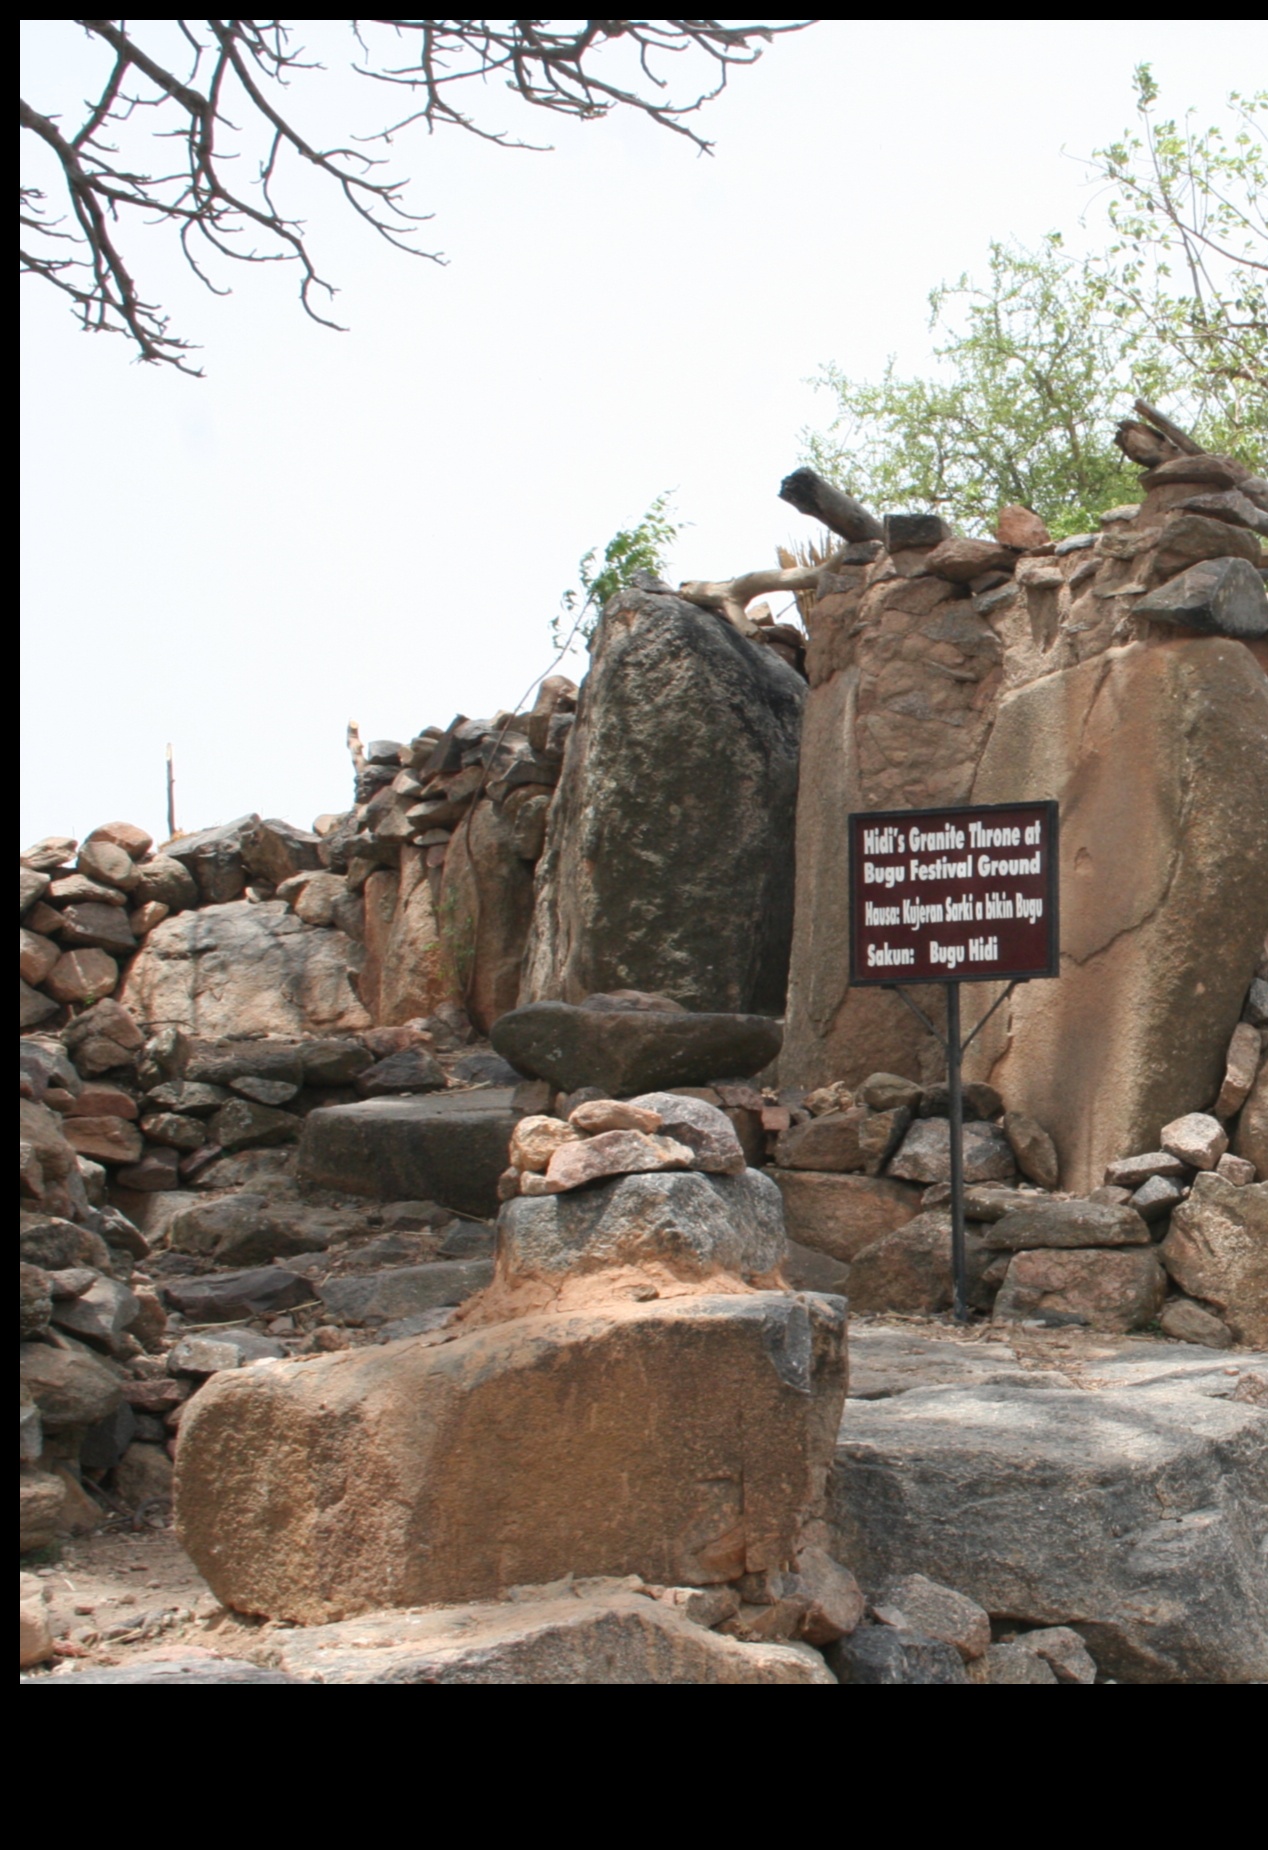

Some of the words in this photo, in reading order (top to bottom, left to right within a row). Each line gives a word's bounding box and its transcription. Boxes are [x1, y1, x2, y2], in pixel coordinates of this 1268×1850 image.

[864, 827, 905, 854] Hidi's
[909, 823, 965, 852] Granite
[969, 821, 1020, 848] Throne
[1025, 820, 1041, 845] at
[864, 862, 904, 888] Bugu
[910, 855, 972, 881] Festival
[978, 851, 1040, 877] Ground
[865, 901, 899, 926] Hausa:
[903, 897, 943, 930] Kujeran
[945, 893, 973, 922] Sarki
[976, 901, 982, 920] a
[985, 892, 1013, 919] bikin
[1016, 893, 1042, 924] Bugu
[867, 942, 914, 966] Sakun:
[930, 941, 964, 968] Bugu
[969, 936, 998, 961] Hidi
